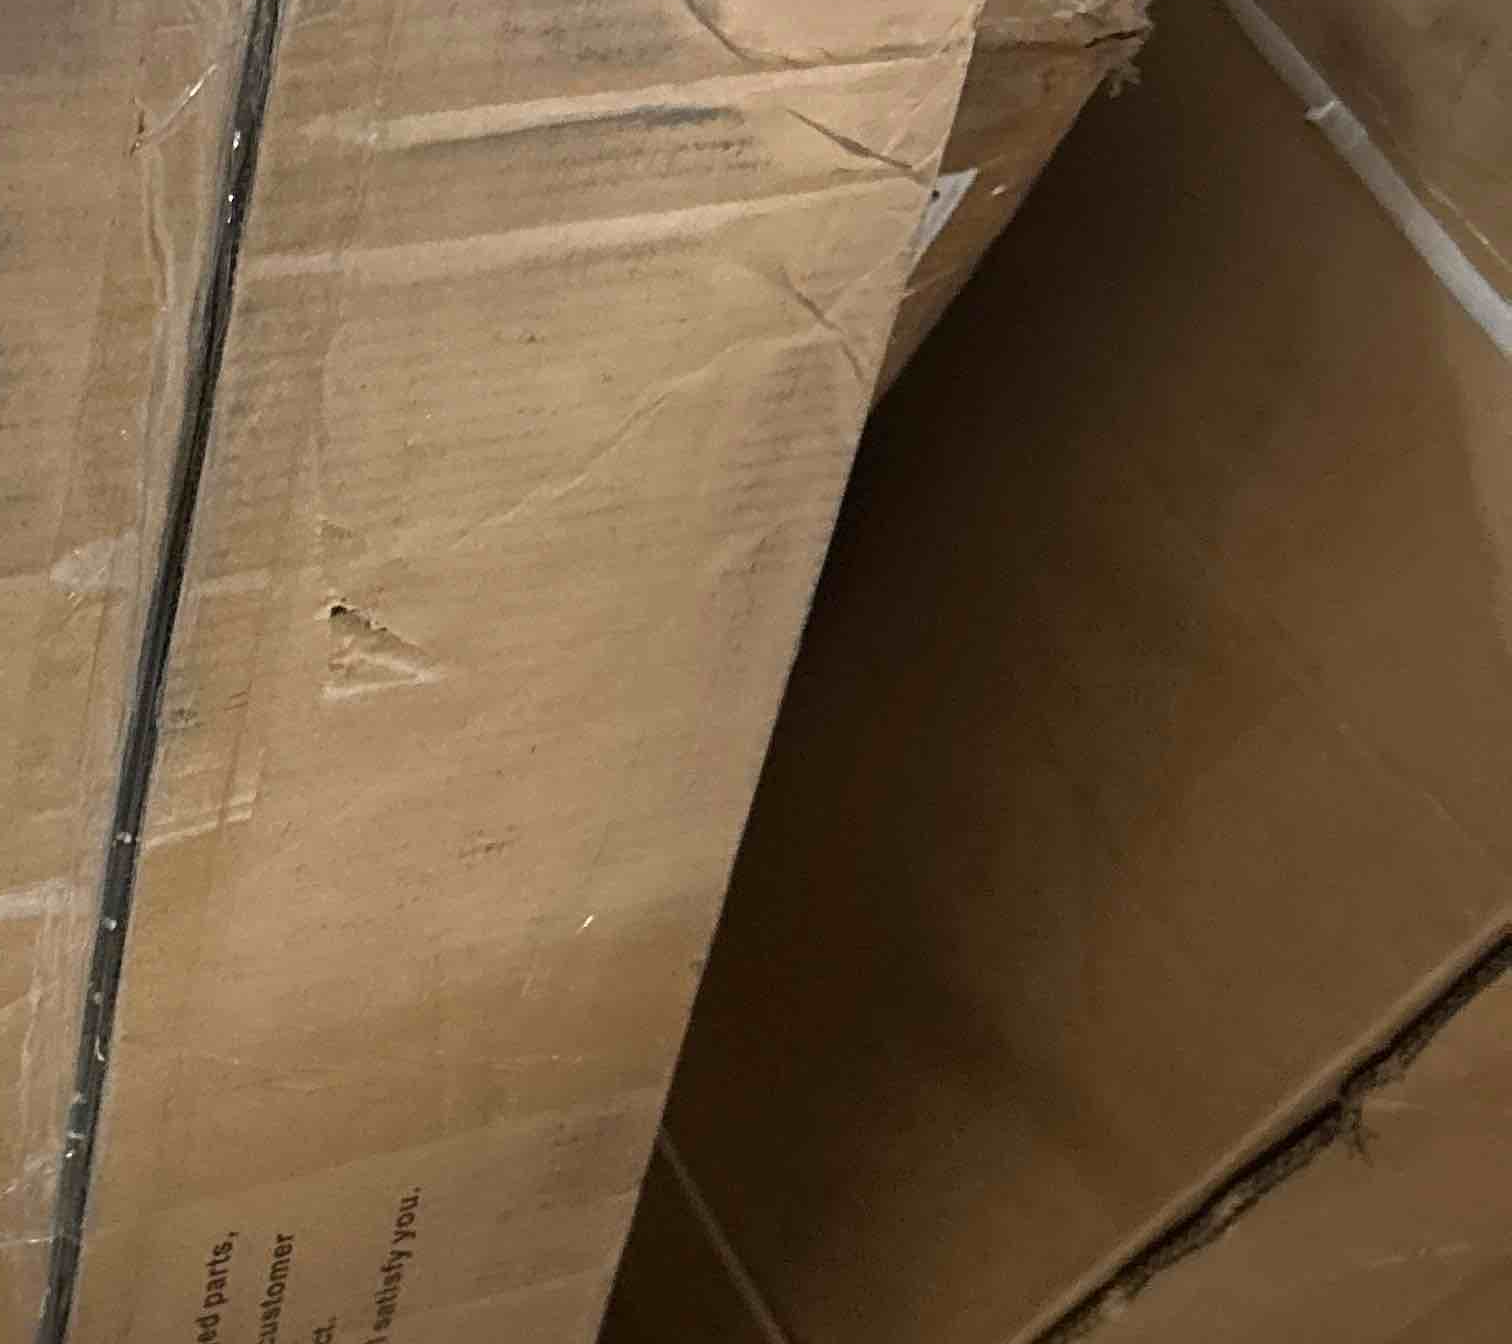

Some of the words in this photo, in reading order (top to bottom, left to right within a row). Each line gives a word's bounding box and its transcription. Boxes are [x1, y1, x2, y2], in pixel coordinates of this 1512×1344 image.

[391, 1187, 421, 1244] you.
[200, 1231, 238, 1308] parts,
[372, 1249, 412, 1331] satisfy
